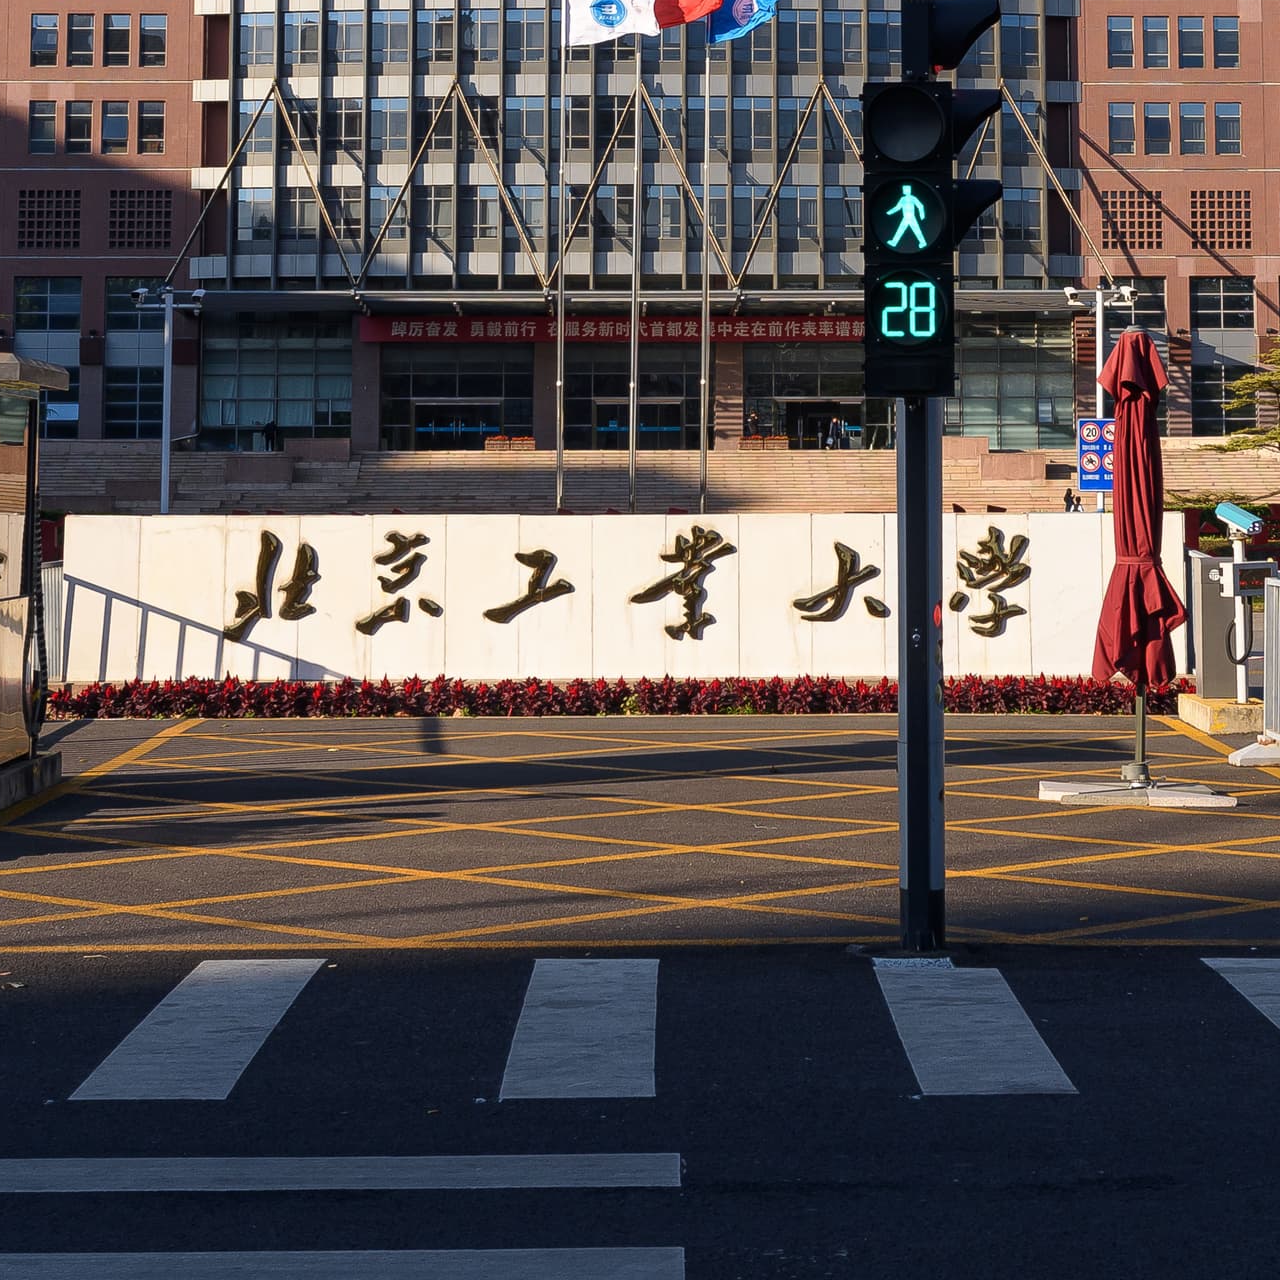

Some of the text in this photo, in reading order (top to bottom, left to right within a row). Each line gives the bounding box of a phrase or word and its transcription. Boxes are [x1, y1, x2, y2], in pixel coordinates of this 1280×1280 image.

[881, 281, 936, 338] 28
[391, 321, 458, 337] 踔厉奋发
[470, 321, 536, 337] 勇毅前行
[1085, 427, 1096, 437] 20
